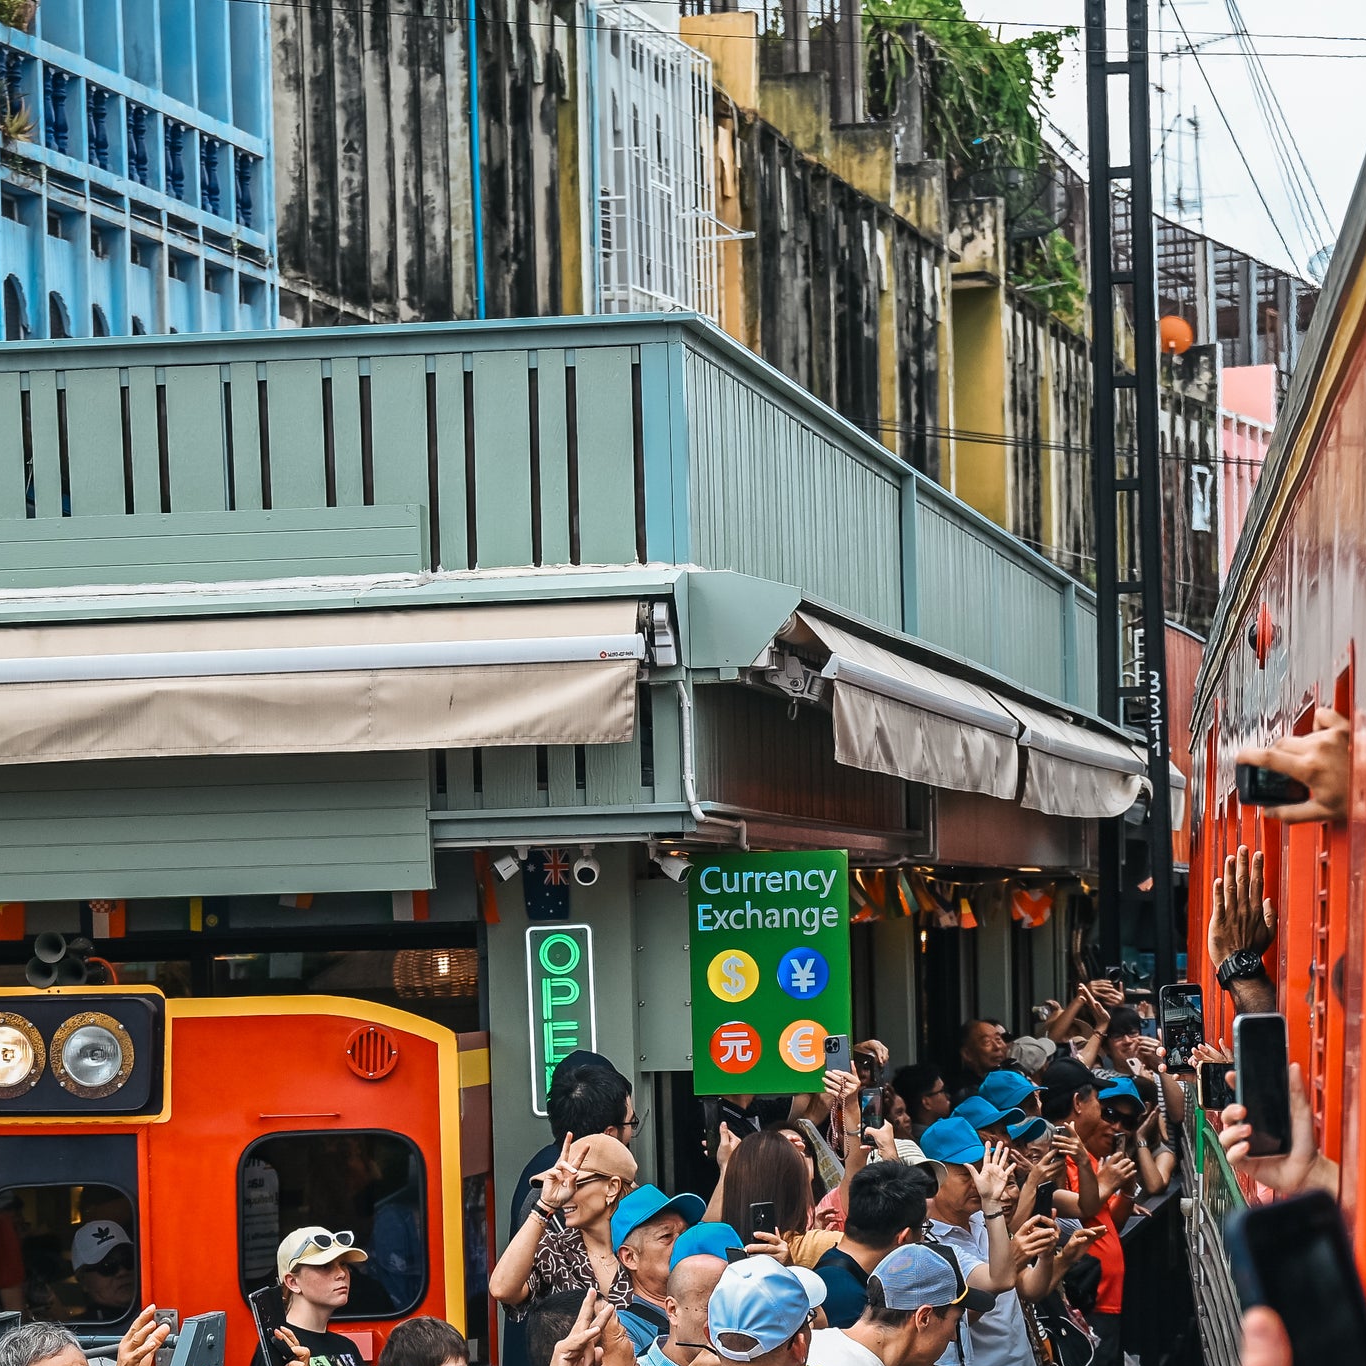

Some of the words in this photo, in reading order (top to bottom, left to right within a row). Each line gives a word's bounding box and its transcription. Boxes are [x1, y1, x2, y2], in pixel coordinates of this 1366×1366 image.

[699, 865, 837, 898] Currency
[697, 901, 839, 936] Exchange
[719, 1031, 753, 1064] 元
